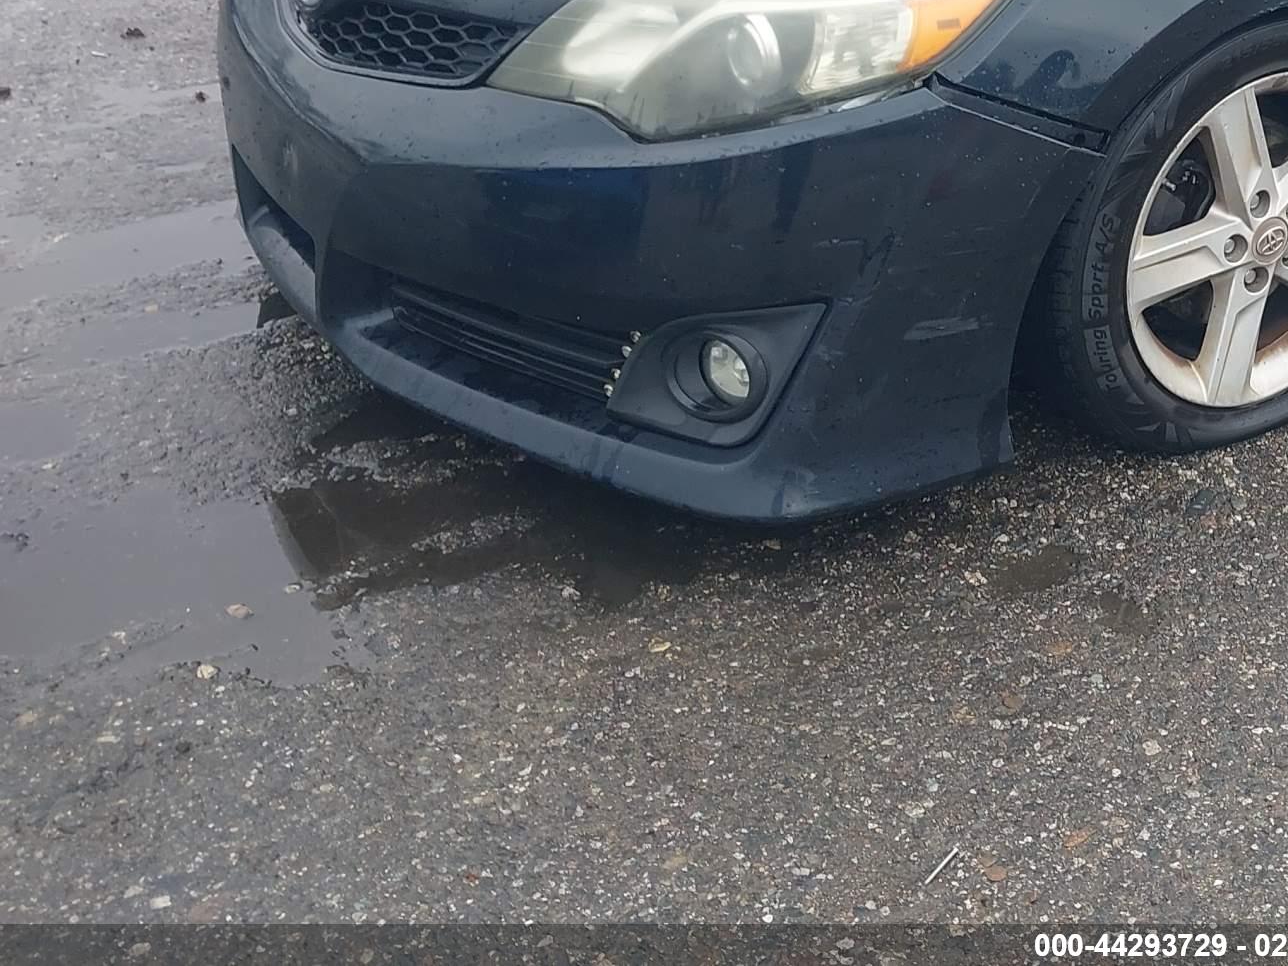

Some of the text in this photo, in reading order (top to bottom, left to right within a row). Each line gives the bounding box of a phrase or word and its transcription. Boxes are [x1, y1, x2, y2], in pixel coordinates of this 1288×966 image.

[1088, 213, 1119, 392] Touring Sport A/S
